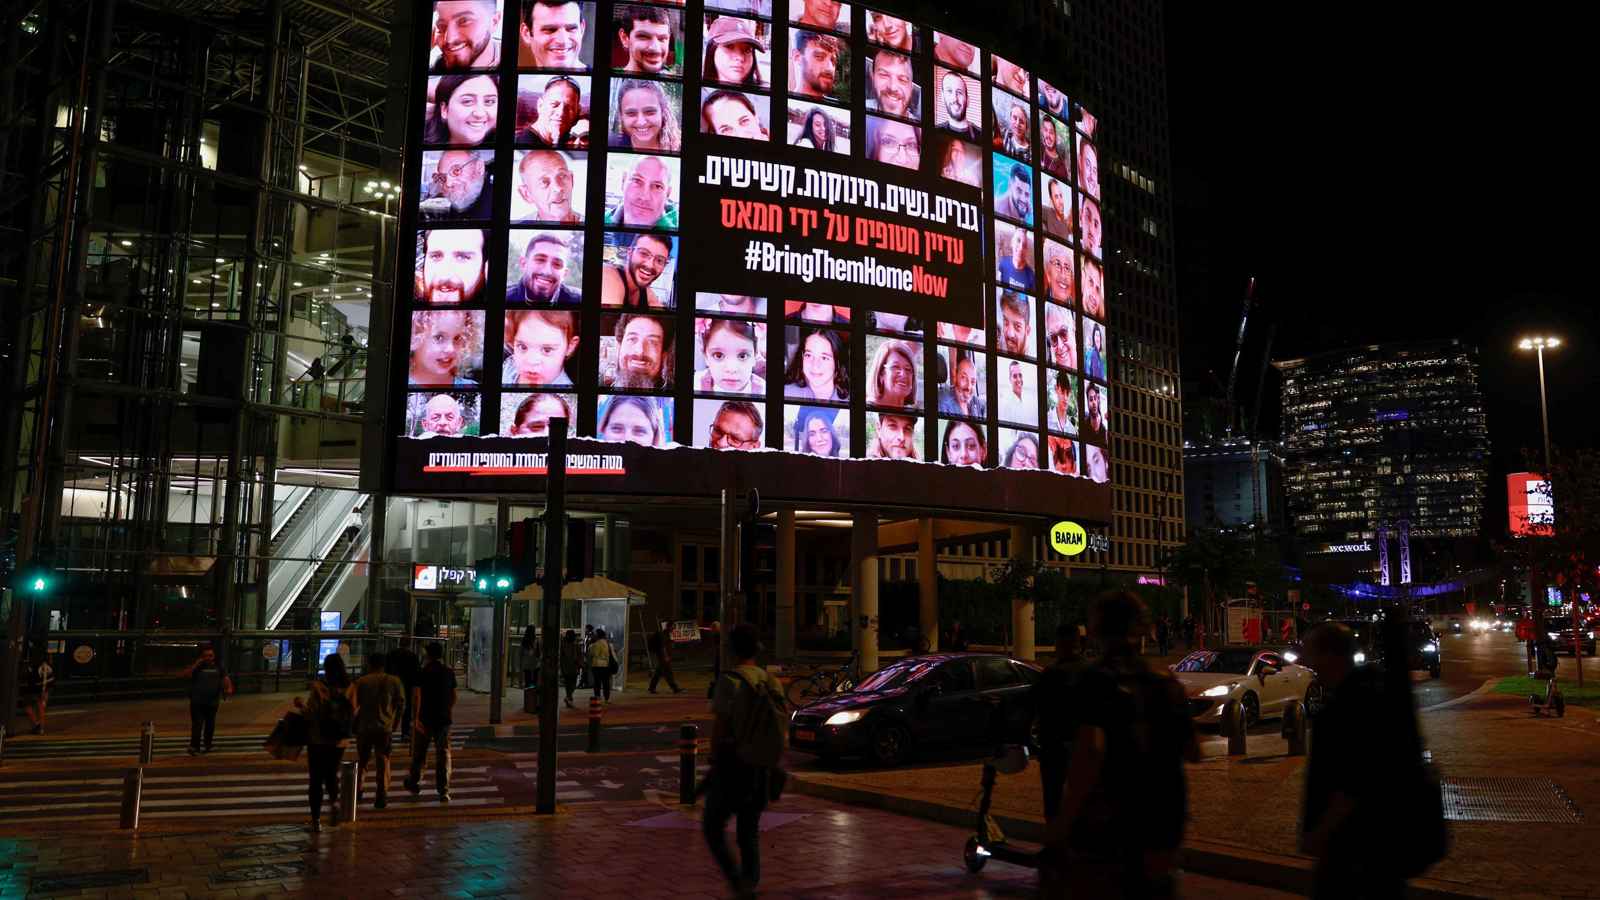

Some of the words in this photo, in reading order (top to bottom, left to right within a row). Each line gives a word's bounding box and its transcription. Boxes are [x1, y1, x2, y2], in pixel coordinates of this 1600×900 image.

[720, 198, 783, 233] חמאס
[789, 206, 818, 237] ידי
[823, 208, 850, 243] על
[855, 217, 920, 256] חטופים
[924, 230, 964, 265] עדיין
[745, 240, 948, 298] #BringThemHomeNow
[473, 452, 514, 467] החטופים
[602, 455, 623, 470] מטה
[1055, 531, 1083, 546] BARAM
[1328, 540, 1371, 552] wework
[439, 566, 465, 584] קפלן
